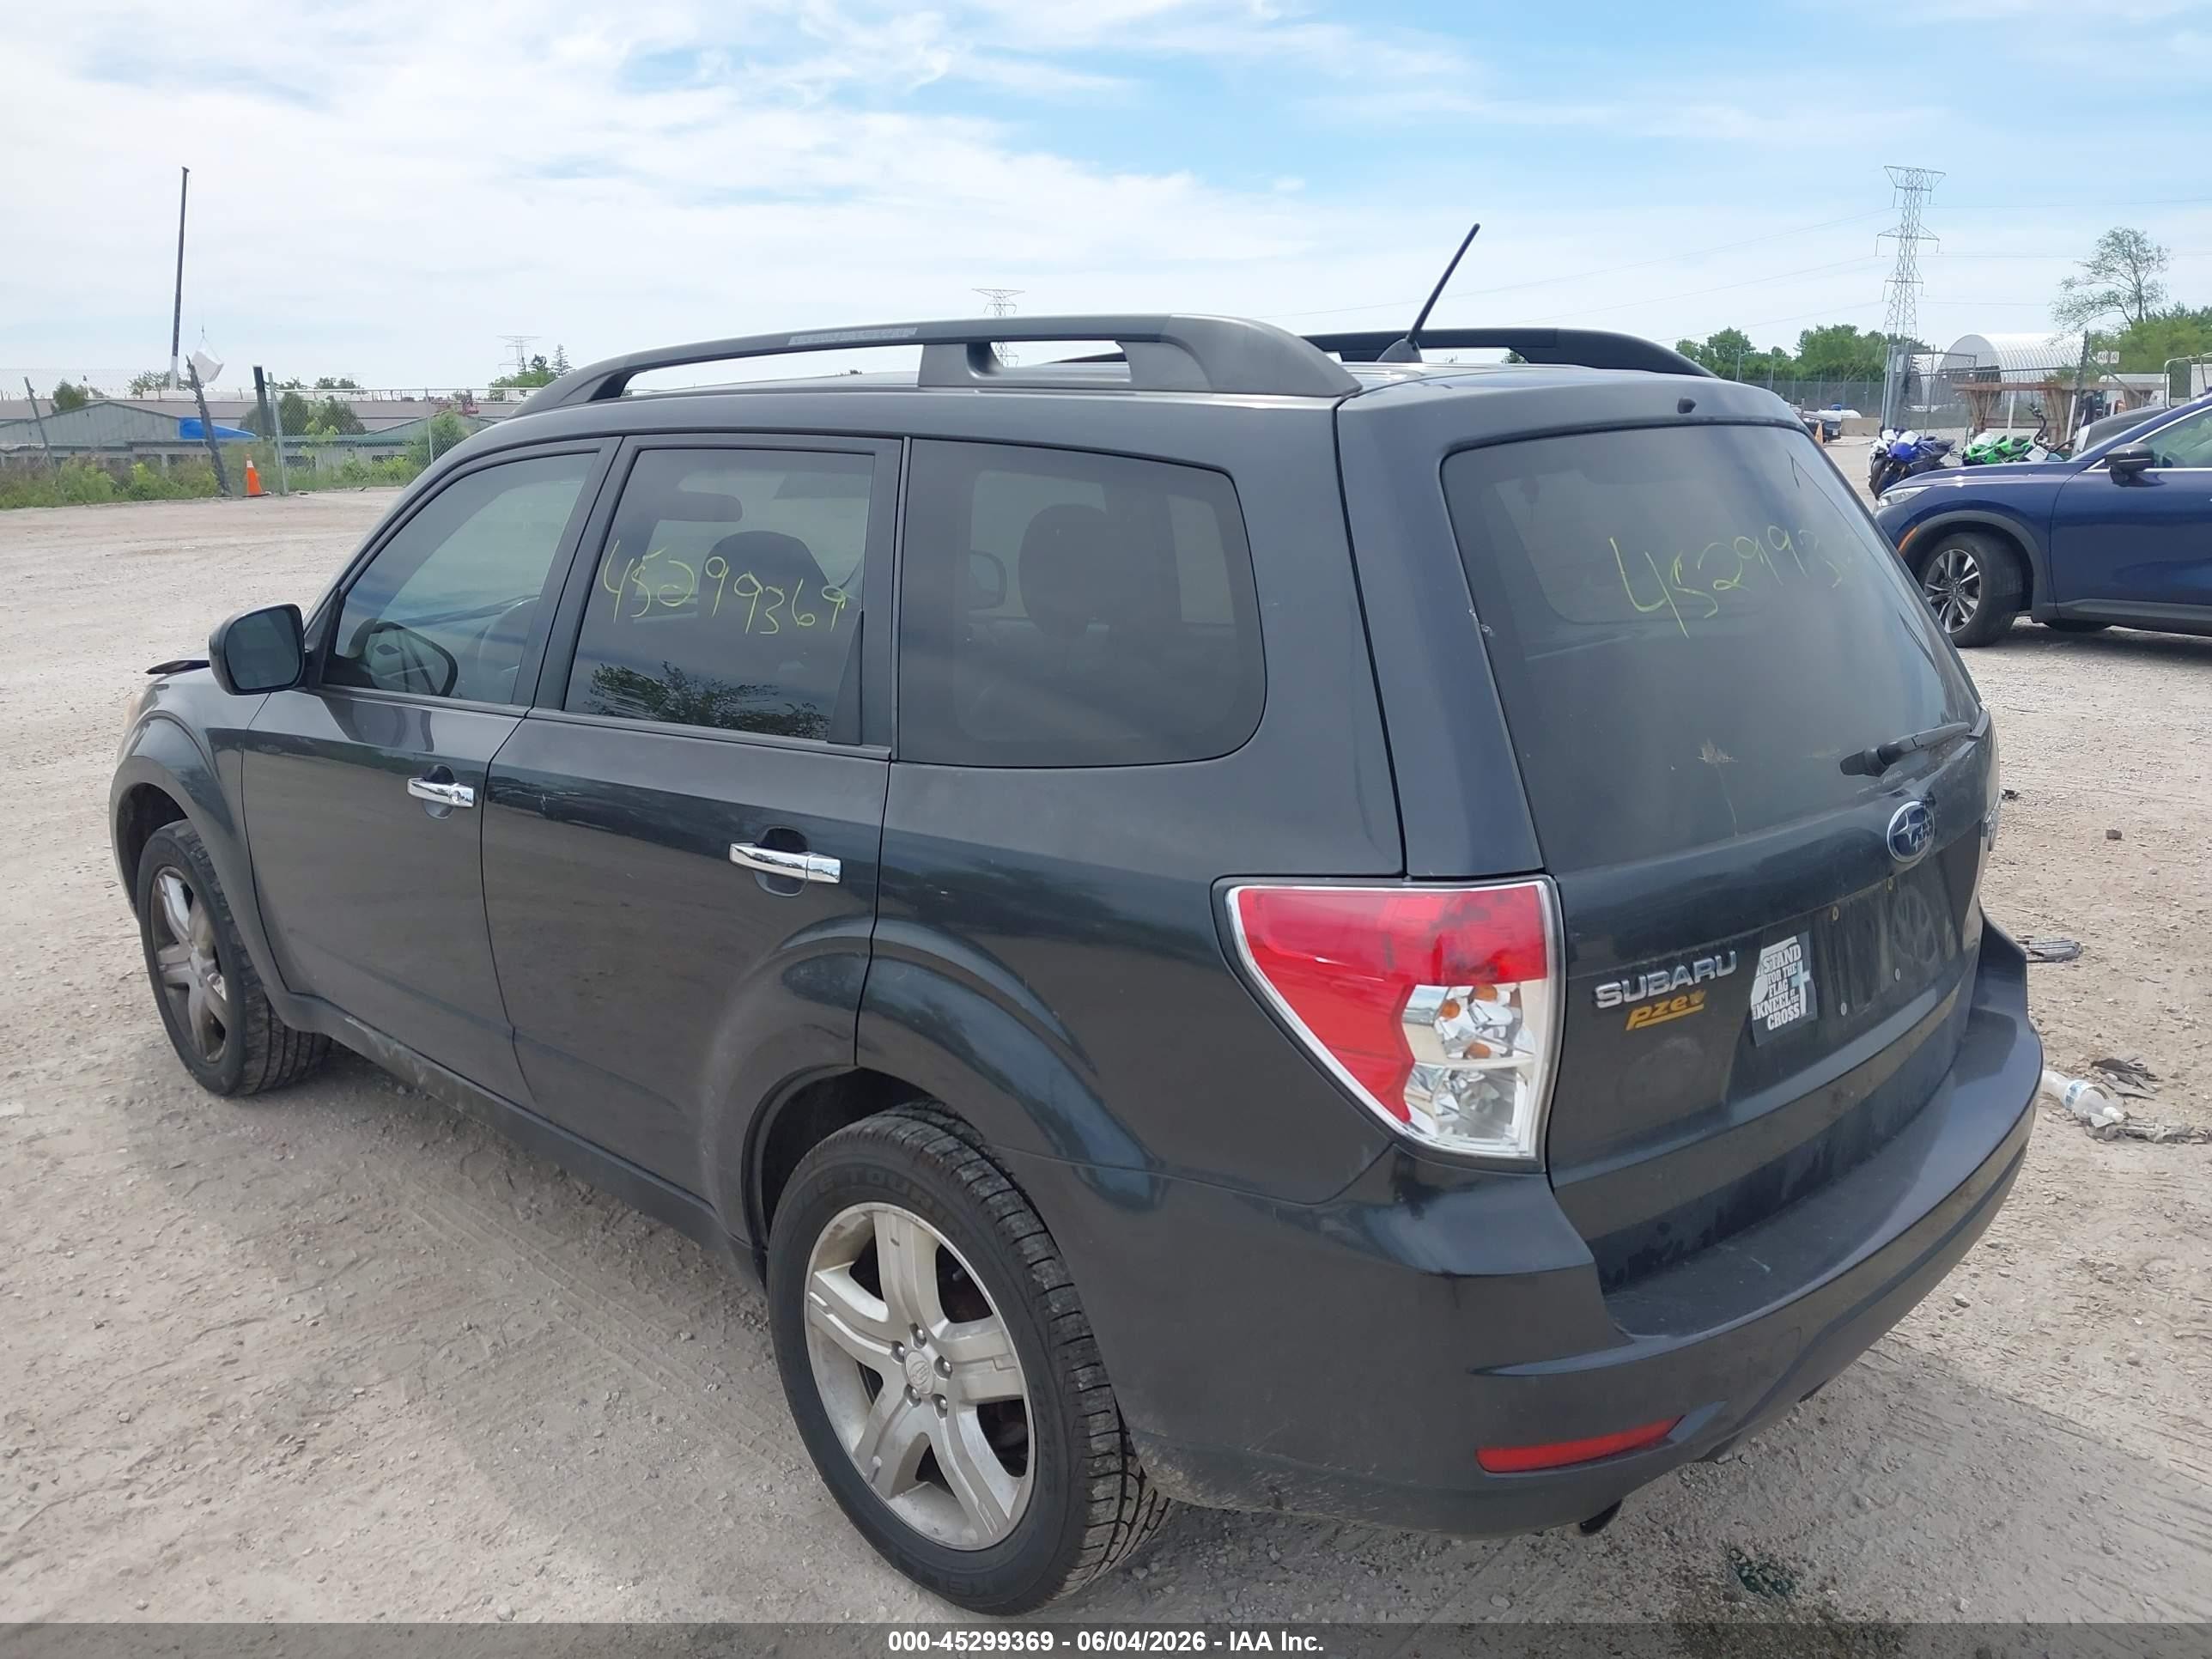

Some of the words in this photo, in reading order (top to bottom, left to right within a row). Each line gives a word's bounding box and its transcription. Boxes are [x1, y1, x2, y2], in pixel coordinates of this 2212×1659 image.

[603, 539, 847, 635] 45299369
[1762, 944, 1802, 974] STAND
[1782, 963, 1797, 978] THE
[1594, 950, 1738, 1009] SUBARU
[1768, 979, 1790, 998] FLAG
[1756, 991, 1791, 1019] KNEEL
[1767, 1002, 1801, 1030] CROSS
